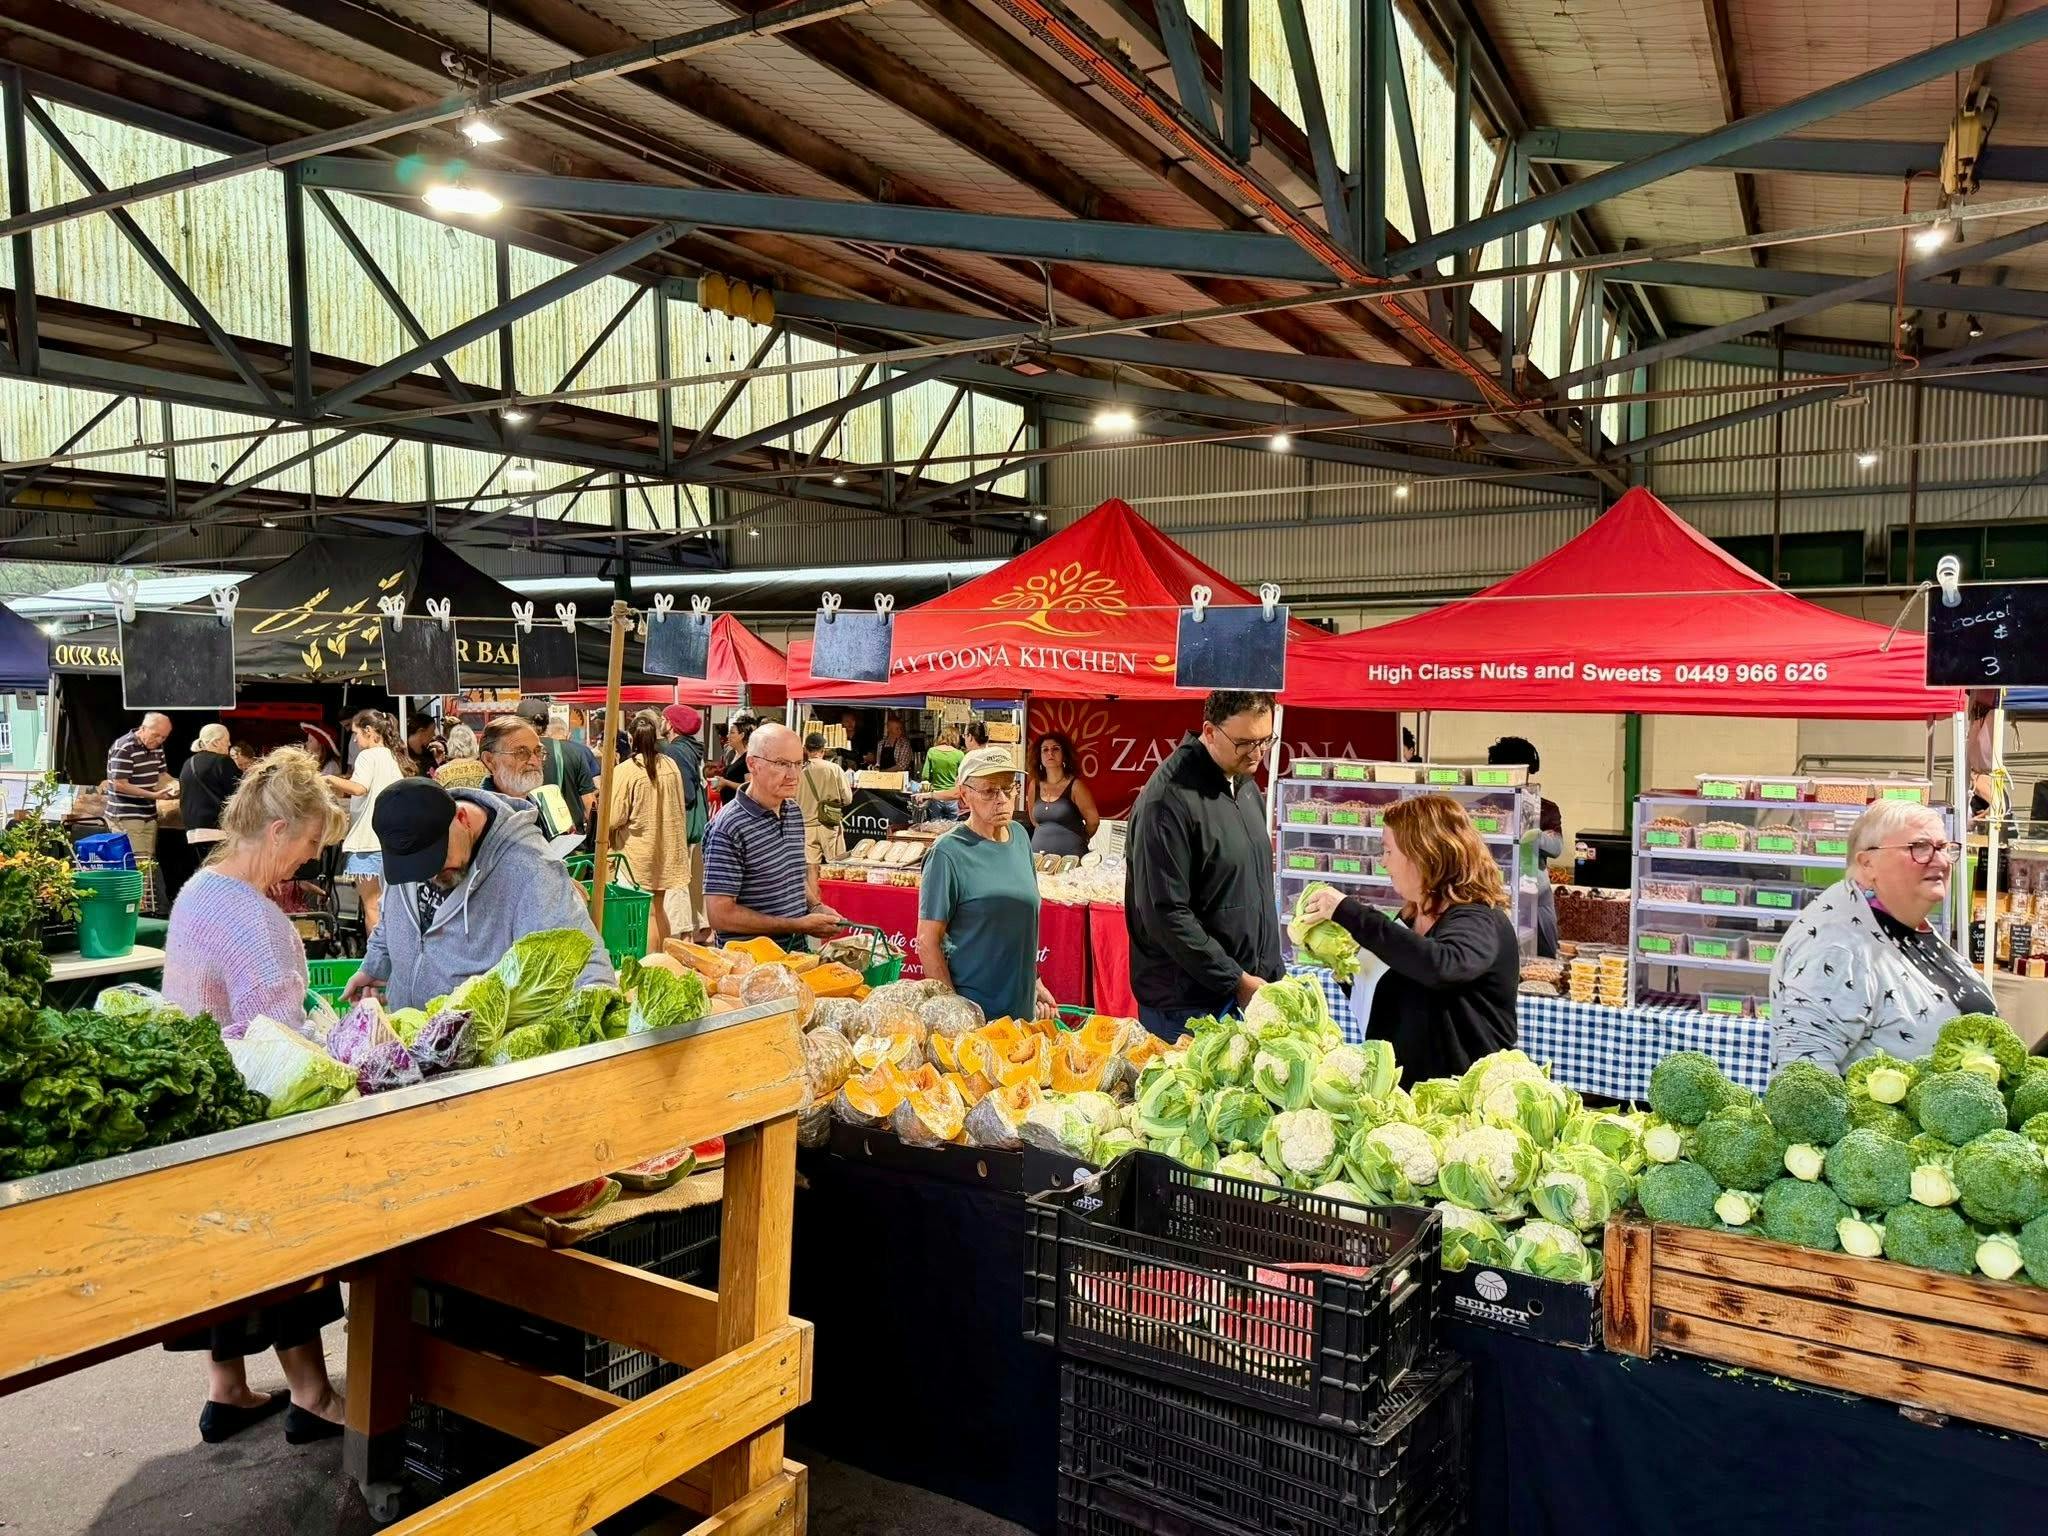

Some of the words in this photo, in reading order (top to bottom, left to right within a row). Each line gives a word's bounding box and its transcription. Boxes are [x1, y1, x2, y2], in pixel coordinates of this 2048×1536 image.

[55, 644, 96, 666] OUR
[891, 644, 1012, 675] AYTOONA
[1019, 646, 1137, 675] KITCHEN
[1981, 656, 2001, 676] 3
[1368, 664, 1412, 684] High
[1418, 663, 1474, 680] Class
[1480, 662, 1528, 679] Nuts
[1534, 662, 1574, 679] and
[1582, 663, 1662, 682] Sweets
[1675, 664, 1729, 683] 0449
[1735, 663, 1778, 683] 966
[1784, 662, 1827, 681] 626
[1455, 1295, 1530, 1322] SELECT
